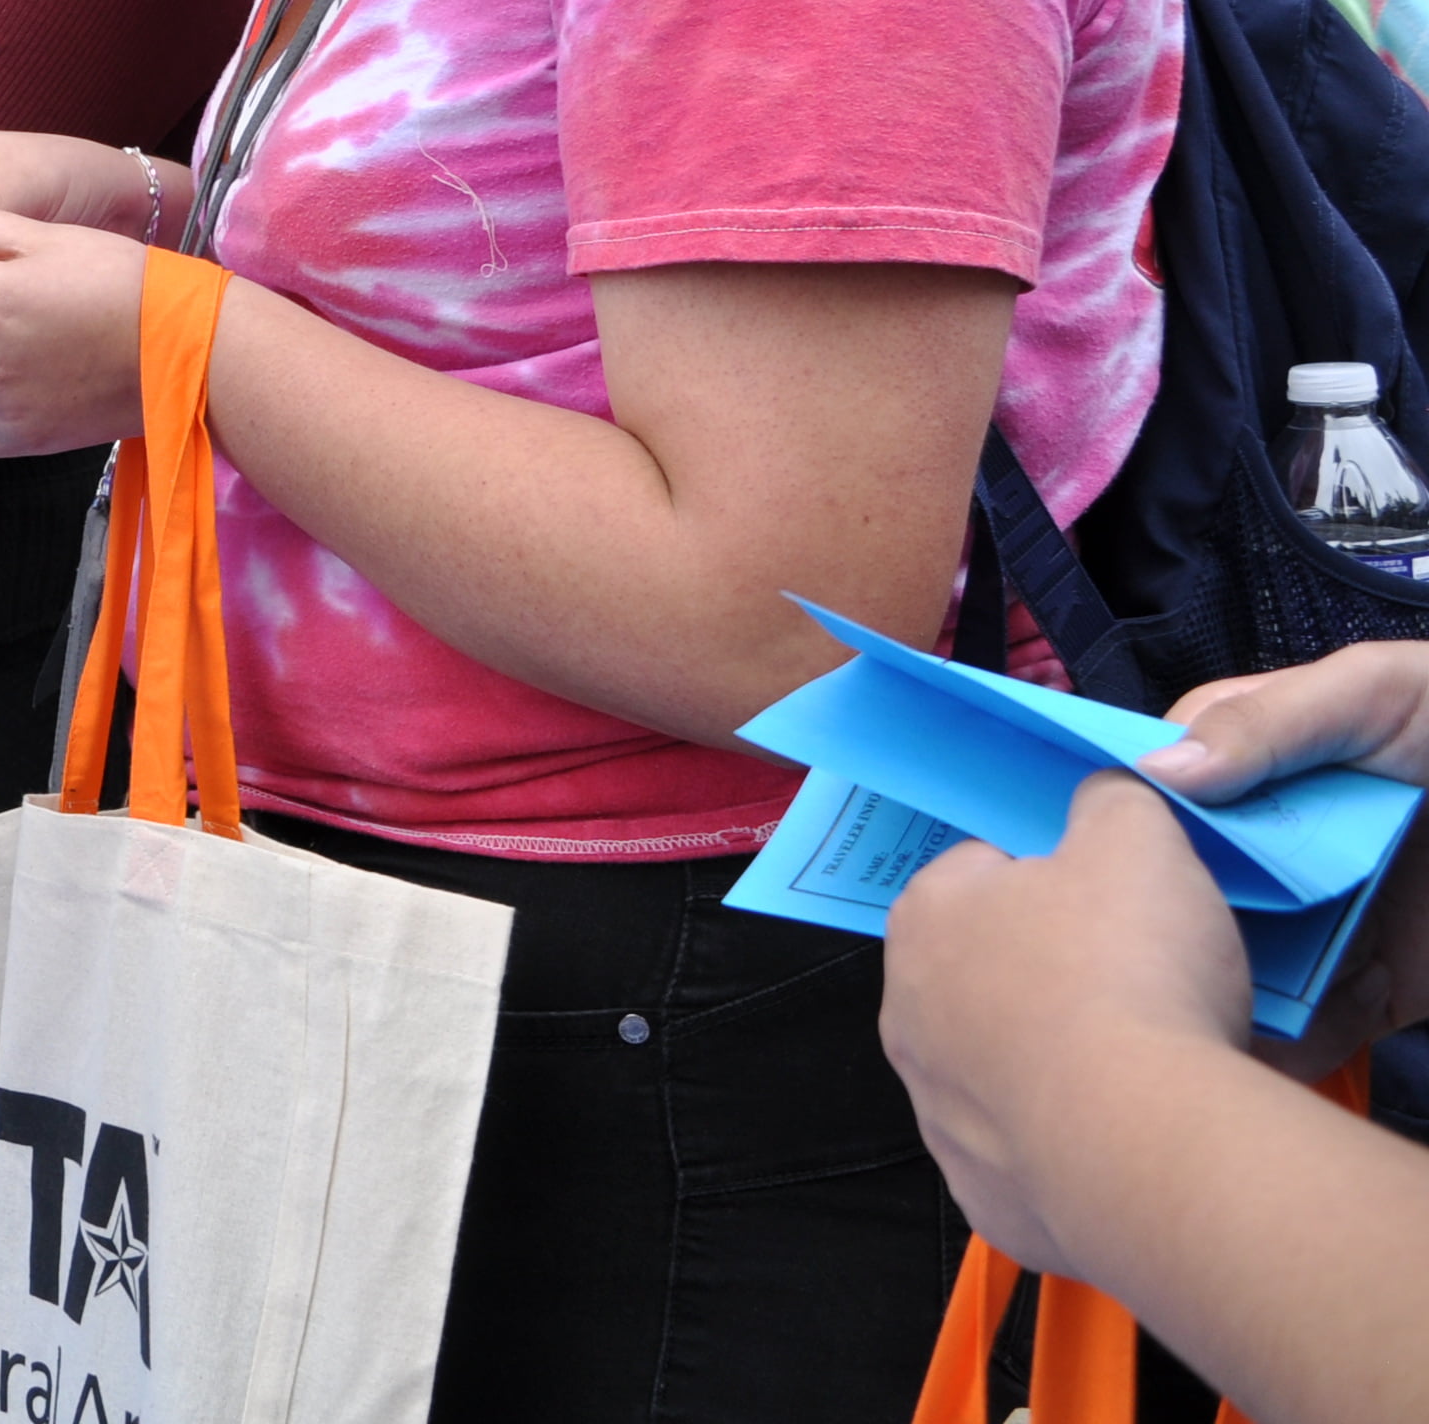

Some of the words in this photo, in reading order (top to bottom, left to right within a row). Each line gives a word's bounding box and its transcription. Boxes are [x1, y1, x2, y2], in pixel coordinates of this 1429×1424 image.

[820, 820, 866, 875] TRAVELER
[860, 792, 882, 822] INFO
[858, 851, 890, 883] NAME:
[878, 849, 914, 888] MAJOR:
